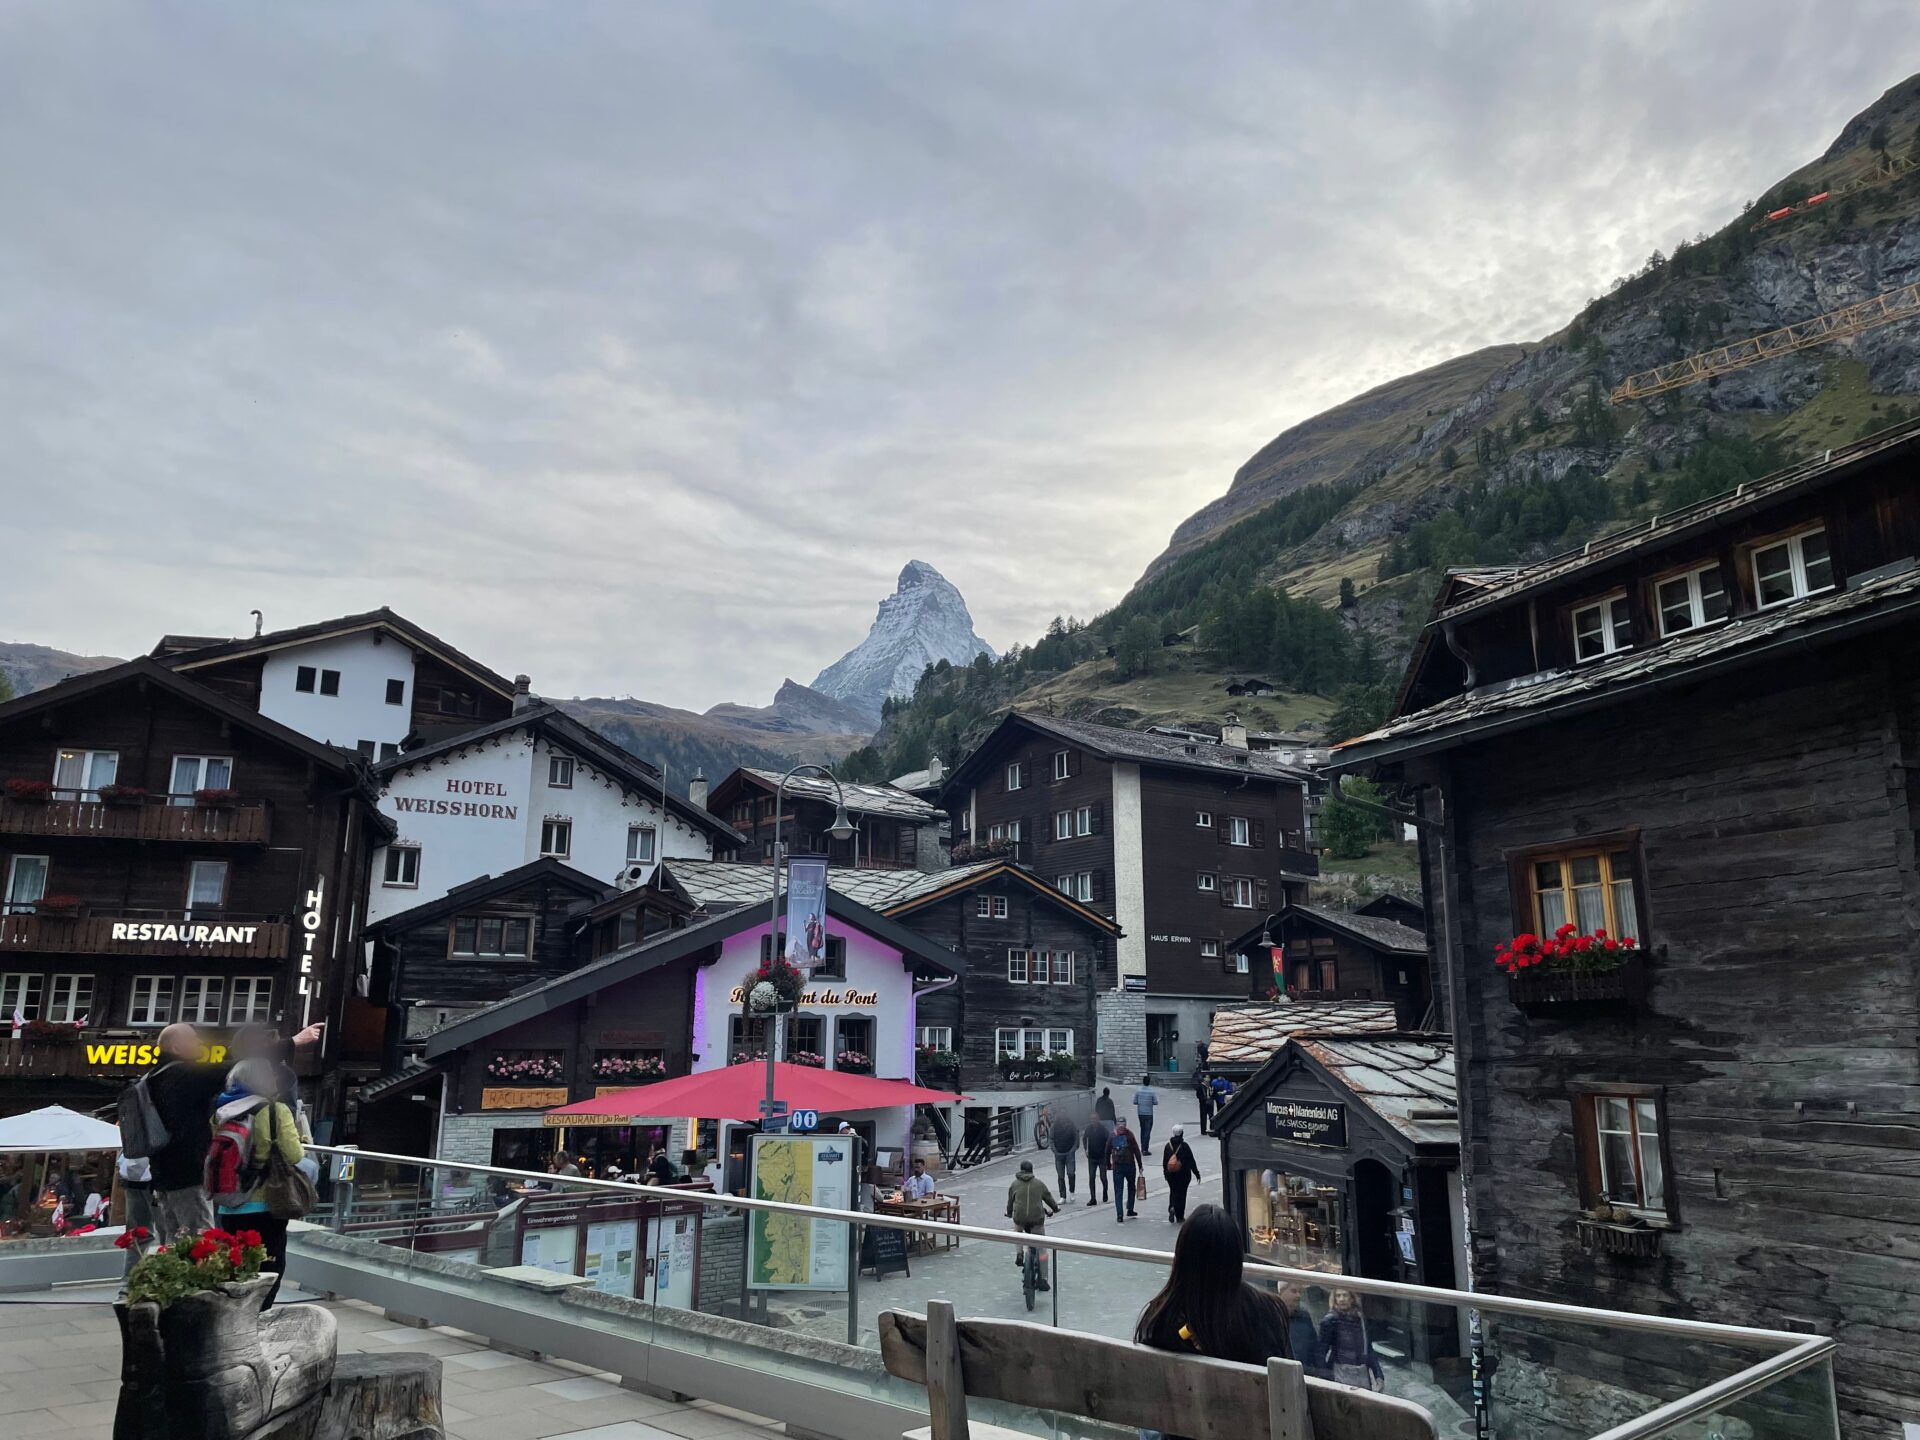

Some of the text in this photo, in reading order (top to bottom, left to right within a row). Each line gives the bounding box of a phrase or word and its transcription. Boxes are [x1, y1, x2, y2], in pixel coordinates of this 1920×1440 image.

[446, 779, 507, 796] HOTEL
[394, 797, 518, 820] WEISSHORN
[111, 922, 258, 943] RESTAURANT
[1150, 934, 1191, 943] HAUS ERWIN
[299, 890, 323, 995] HOTEL
[820, 988, 839, 1004] du
[844, 989, 878, 1005] Pont
[547, 1114, 629, 1125] RESTAURANT Du Pont
[1266, 1101, 1288, 1115] Marcus
[1327, 1108, 1338, 1121] AG
